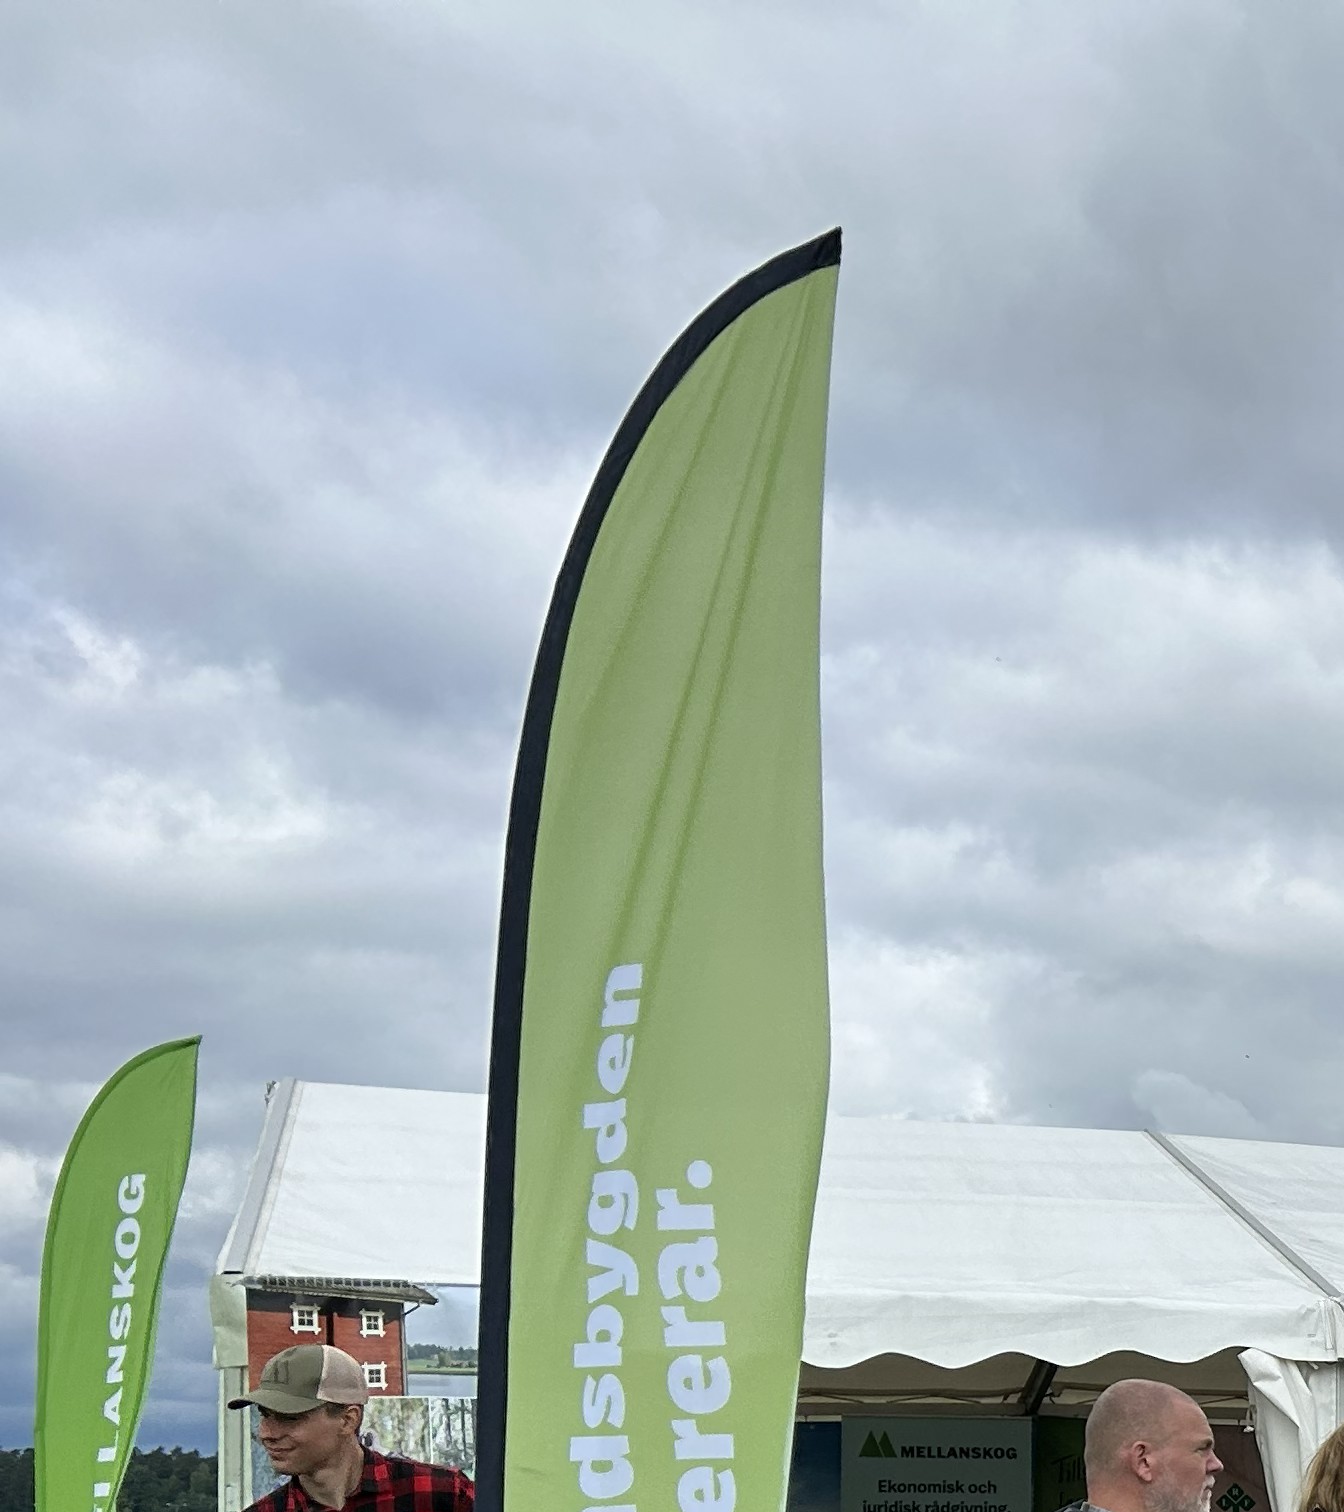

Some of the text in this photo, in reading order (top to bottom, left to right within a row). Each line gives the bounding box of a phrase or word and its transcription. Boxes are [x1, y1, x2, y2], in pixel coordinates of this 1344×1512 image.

[900, 1446, 1017, 1459] MELLANSKOG
[878, 1479, 997, 1494] Ekonomisk och
